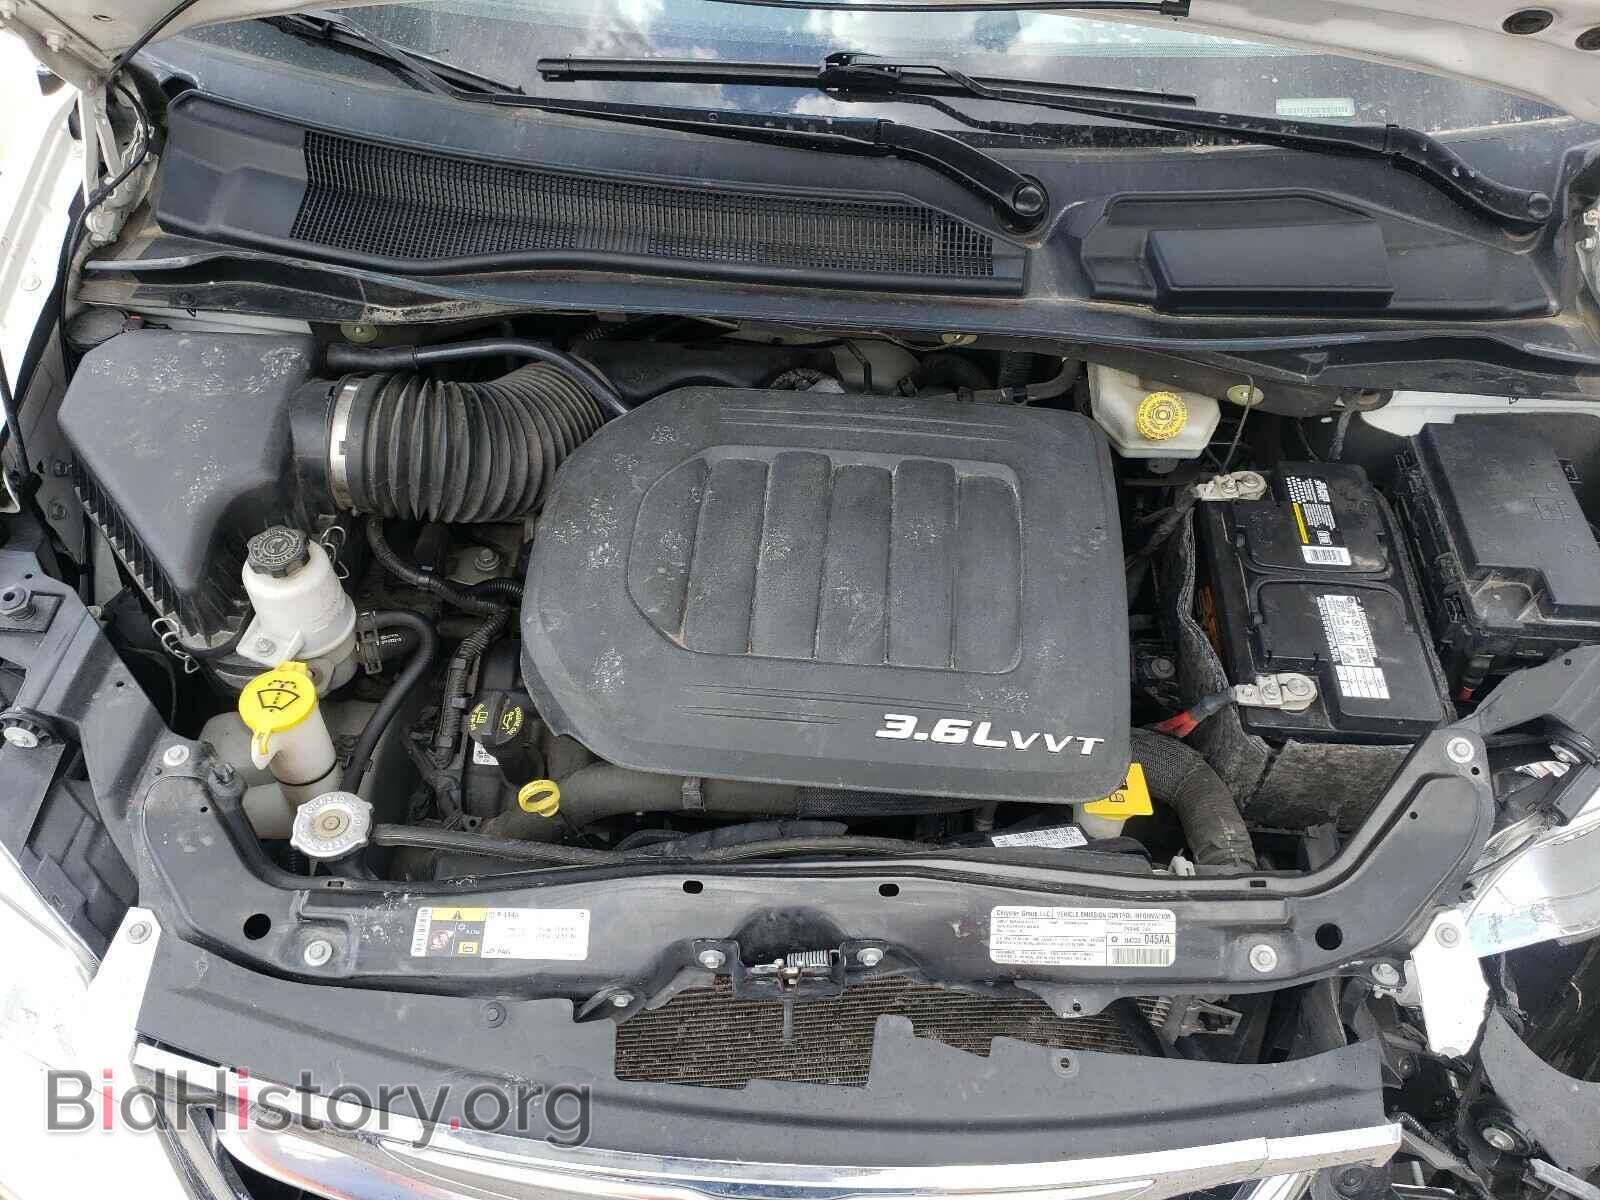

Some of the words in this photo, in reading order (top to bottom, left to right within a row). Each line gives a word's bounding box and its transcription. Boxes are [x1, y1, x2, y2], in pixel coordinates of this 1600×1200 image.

[1010, 730, 1105, 756] VVT
[1080, 911, 1107, 919] EMISSION
[1107, 912, 1132, 920] CONTROL
[1133, 912, 1172, 920] INFORMATION
[1144, 934, 1171, 945] 045AA
